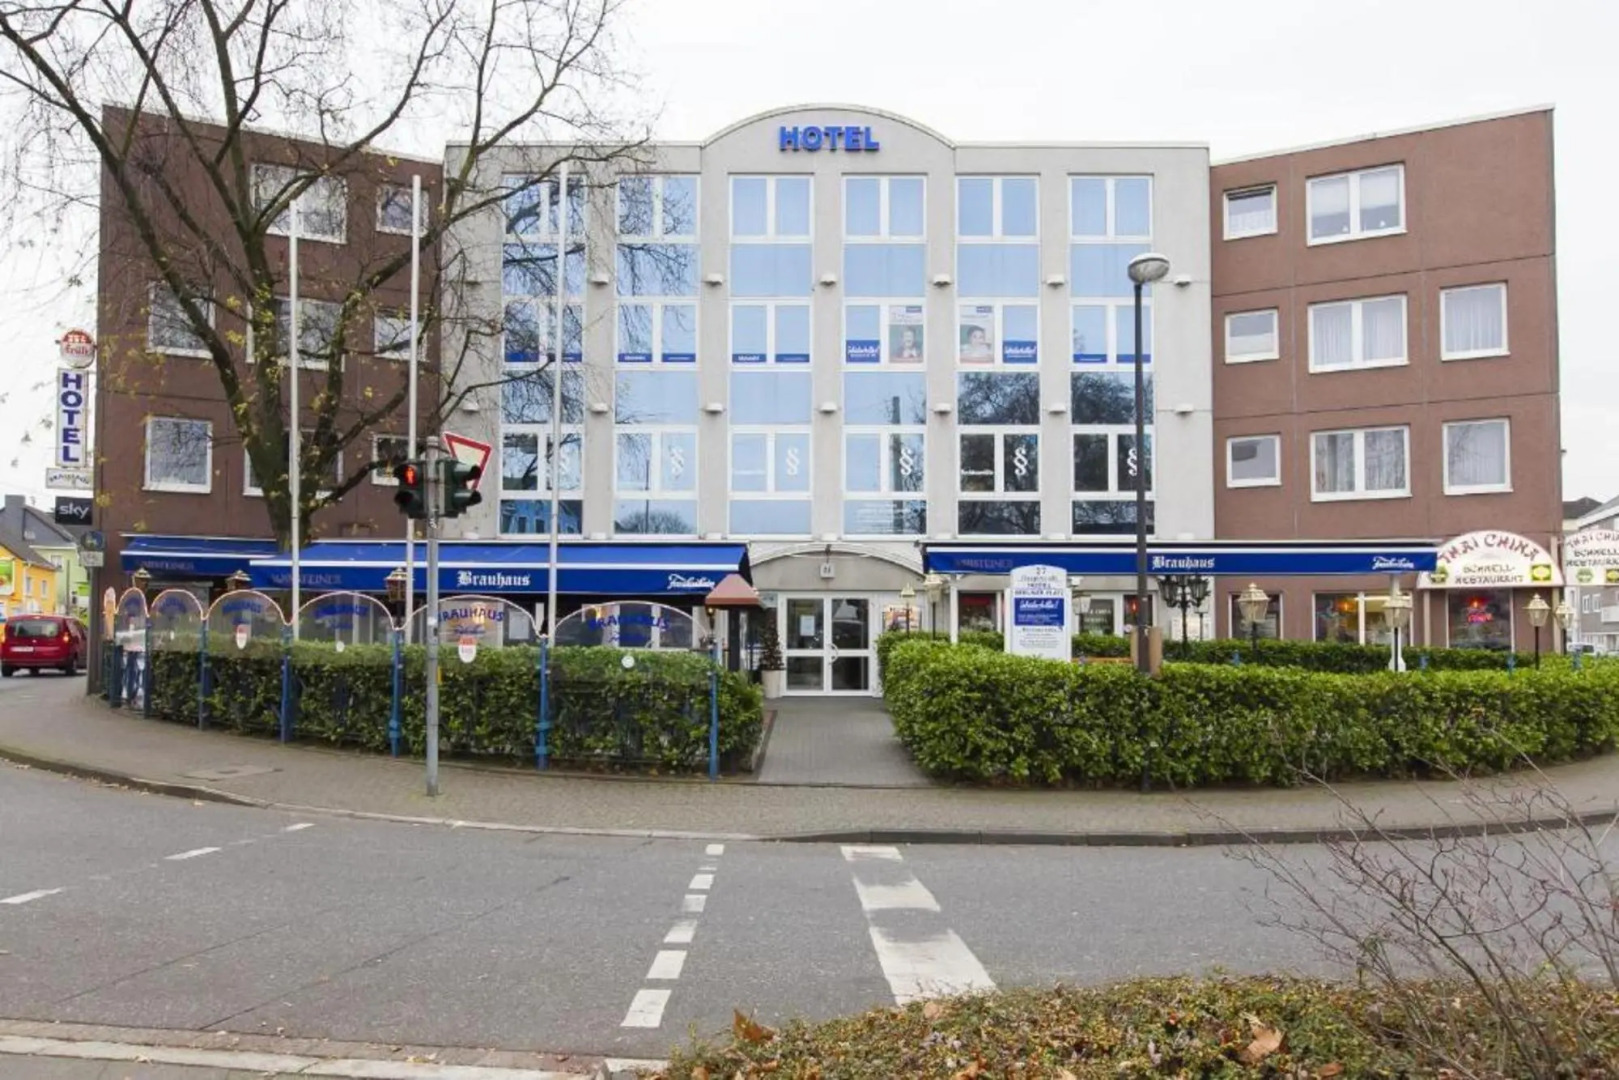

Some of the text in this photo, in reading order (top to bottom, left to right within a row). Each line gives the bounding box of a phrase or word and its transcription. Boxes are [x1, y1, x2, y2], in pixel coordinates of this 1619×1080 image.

[779, 126, 880, 152] HOTEL
[60, 372, 84, 463] HOTEL
[59, 502, 89, 519] sky
[1484, 533, 1539, 561] CHINA
[1152, 555, 1215, 570] Brauhaus
[457, 569, 531, 588] Brauhaus
